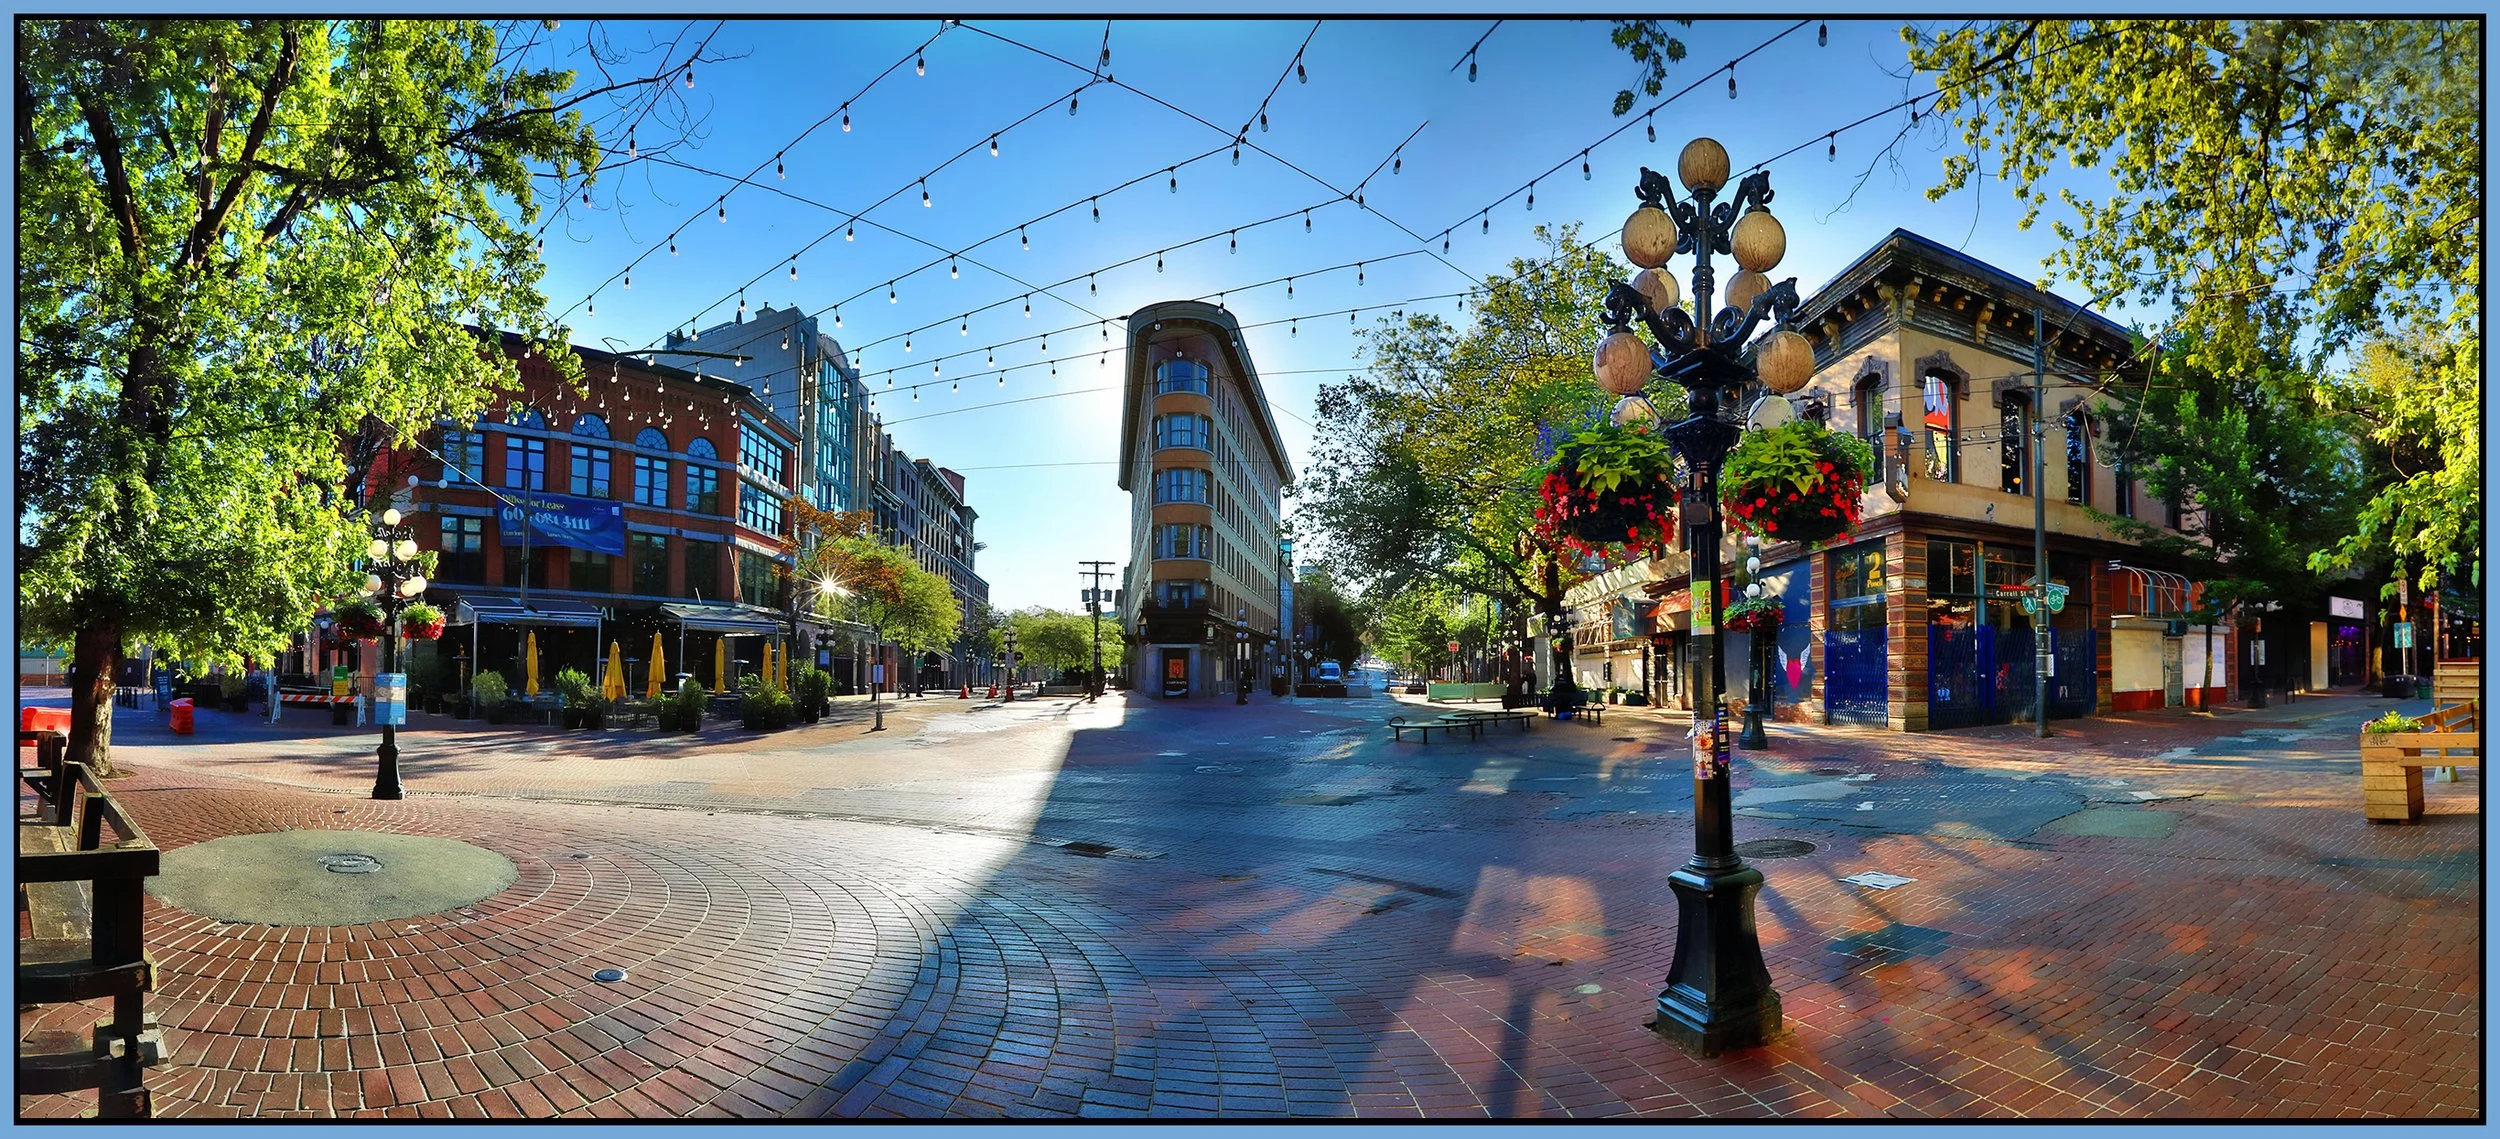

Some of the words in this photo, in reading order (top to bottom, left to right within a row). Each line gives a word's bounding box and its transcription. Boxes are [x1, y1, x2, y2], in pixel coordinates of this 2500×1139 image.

[541, 500, 565, 511] Lease
[562, 515, 591, 531] 4111
[1868, 551, 1881, 579] 2
